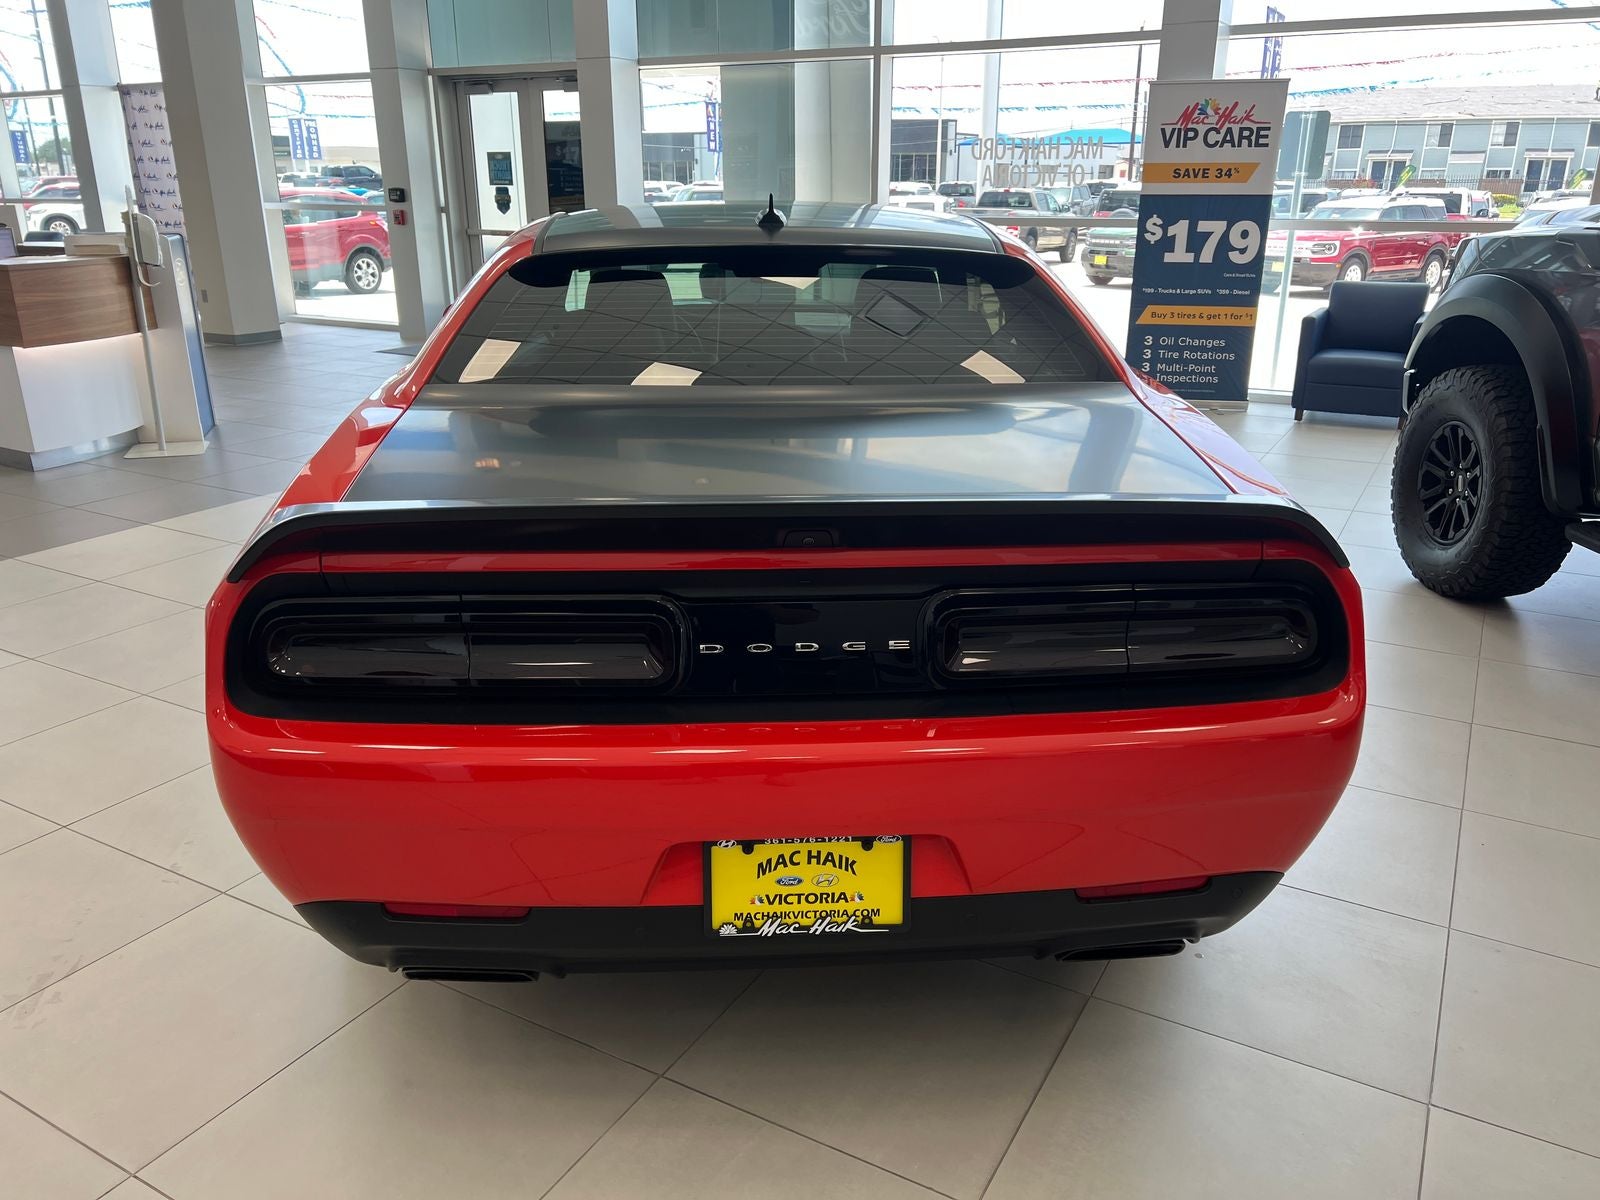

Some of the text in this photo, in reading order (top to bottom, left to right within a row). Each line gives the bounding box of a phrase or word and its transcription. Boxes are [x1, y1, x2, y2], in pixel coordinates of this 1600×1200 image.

[1161, 101, 1271, 131] Mac Haik
[1160, 126, 1271, 148] VIP CARE
[1172, 167, 1240, 179] SAVE 34%
[1144, 214, 1261, 266] $179
[1151, 311, 1167, 319] Buy
[1230, 312, 1243, 320] for
[1143, 336, 1226, 348] 3 Oil Changes
[1142, 349, 1235, 360] 3 Tire Rotations
[1141, 363, 1216, 373] 3 Multi-Point
[1156, 373, 1219, 384] Inspections
[699, 639, 910, 654] DODGE
[756, 849, 857, 879] MAC HAIK
[779, 876, 800, 886] Ford
[764, 891, 850, 906] VICTORIA
[757, 915, 872, 937] Mac Haik
